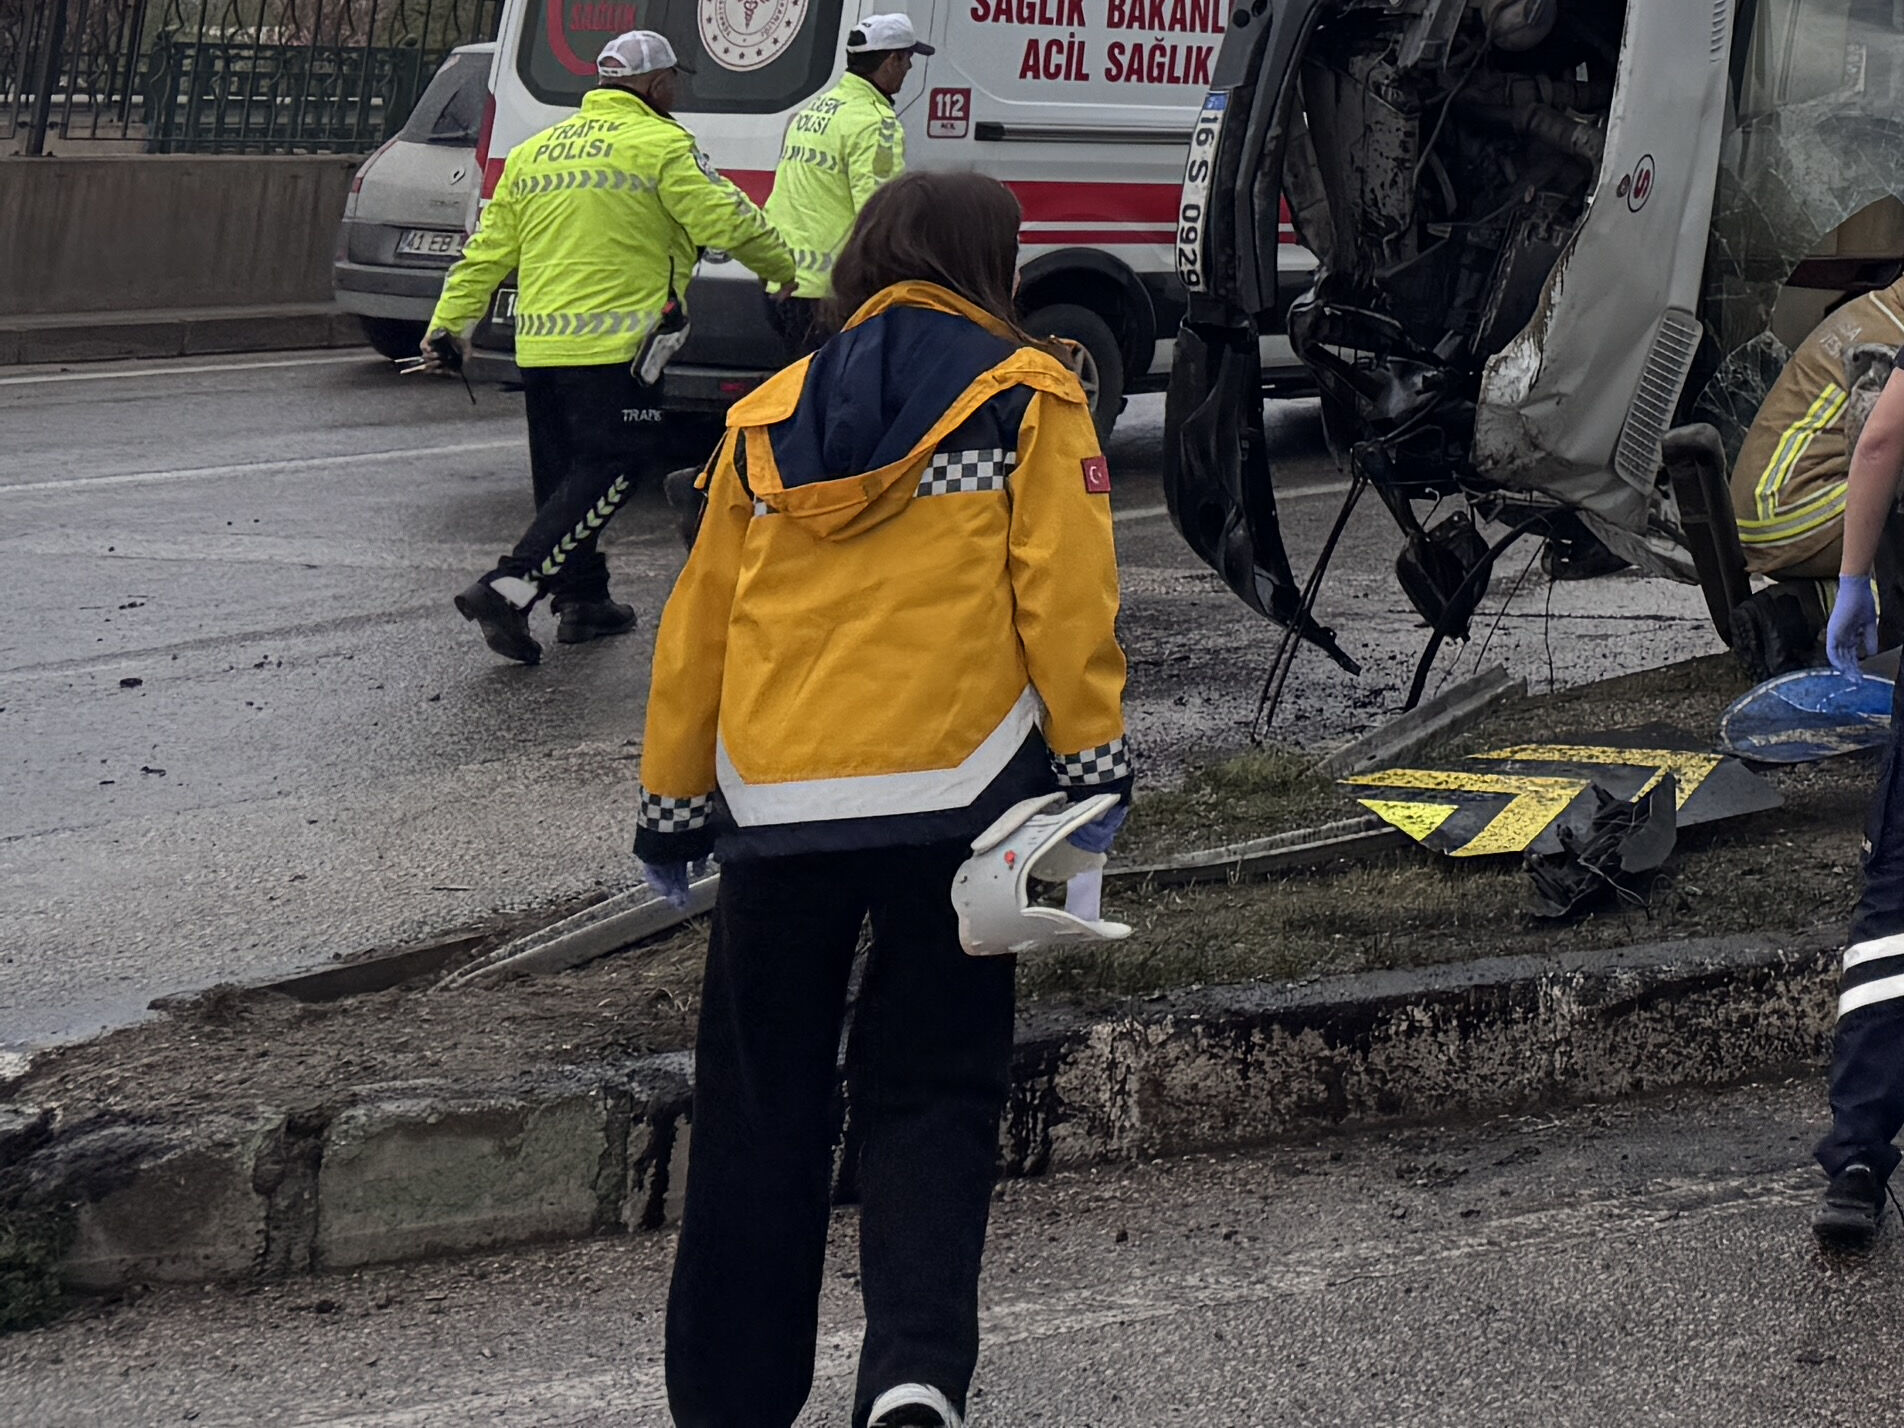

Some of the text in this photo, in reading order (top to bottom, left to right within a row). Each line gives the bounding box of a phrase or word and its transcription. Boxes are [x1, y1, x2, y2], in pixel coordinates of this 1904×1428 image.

[1018, 31, 1215, 86] ACİL SAĞLIK
[935, 93, 964, 117] 112
[1196, 114, 1219, 147] 16
[1188, 159, 1209, 183] S
[1178, 203, 1201, 287] 0929
